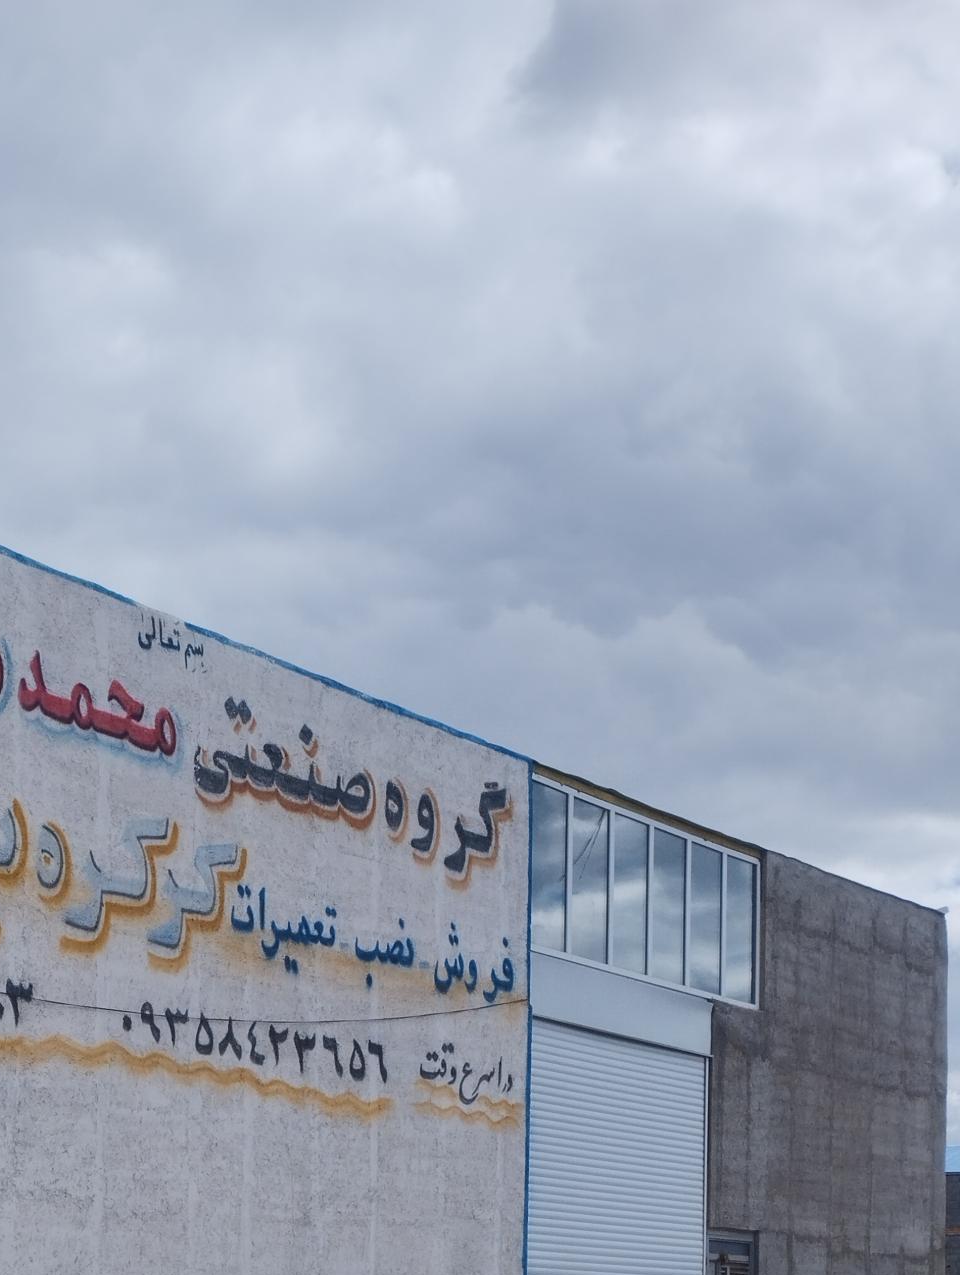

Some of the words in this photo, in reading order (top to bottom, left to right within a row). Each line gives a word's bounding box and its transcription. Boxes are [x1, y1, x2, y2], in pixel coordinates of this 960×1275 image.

[18, 648, 178, 758] محمد
[193, 696, 374, 819] صنعتی
[384, 781, 510, 878] گروه
[37, 817, 244, 958] کرکره
[230, 883, 339, 976] تعمیرات
[354, 917, 416, 990] نصب
[433, 922, 515, 1003] فروش
[420, 1042, 458, 1086] وقت
